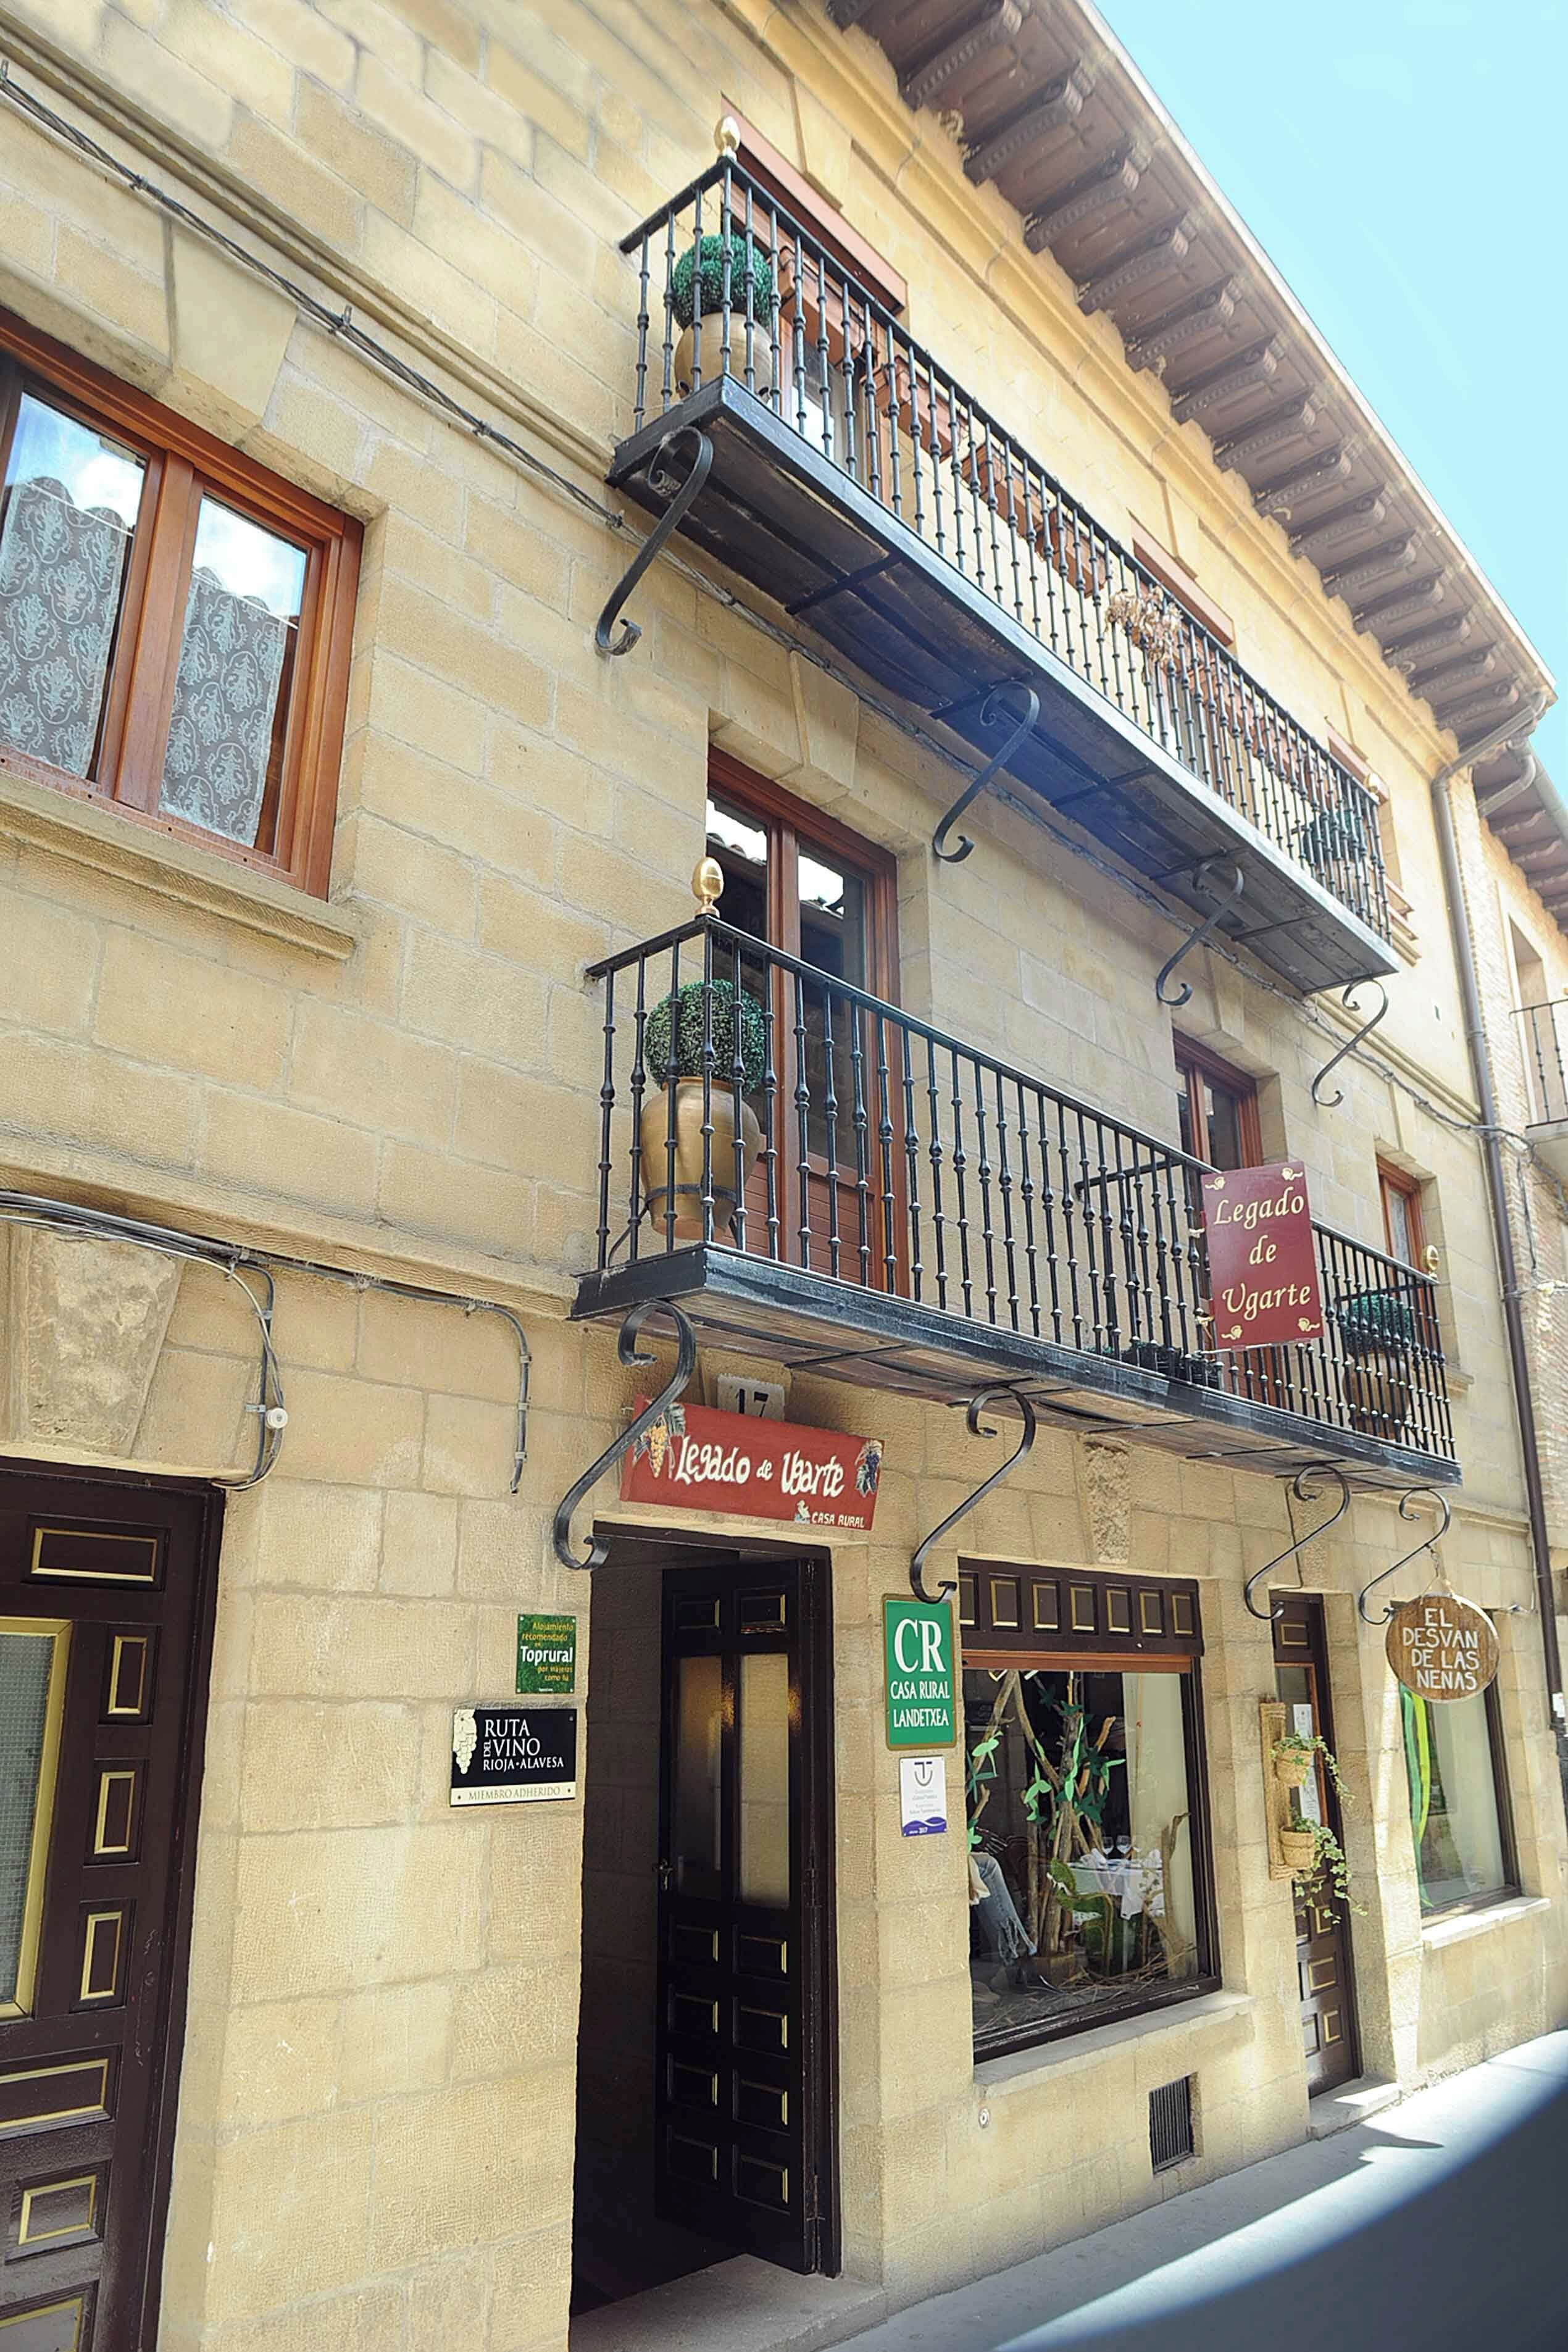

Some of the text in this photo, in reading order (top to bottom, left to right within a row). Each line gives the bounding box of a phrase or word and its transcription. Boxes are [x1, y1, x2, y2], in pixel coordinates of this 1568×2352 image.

[1214, 1186, 1304, 1230] Legado
[1249, 1235, 1277, 1265] de
[1222, 1283, 1311, 1320] Ugarte
[735, 1388, 770, 1417] 17
[674, 1435, 845, 1497] Legado de Ugarte
[811, 1511, 865, 1528] CASA RURAL
[1425, 1608, 1453, 1628] EL
[894, 1618, 946, 1673] CR
[1402, 1627, 1478, 1649] DESVAN
[520, 1646, 573, 1666] Toprural
[1412, 1649, 1480, 1670] DE LAS
[890, 1680, 951, 1699] CASA RURAL
[1416, 1669, 1477, 1691] NENAS
[893, 1708, 949, 1727] LANDETXEA
[485, 1719, 530, 1738] RUTA
[483, 1739, 491, 1758] DEL
[493, 1738, 541, 1757] VINO
[469, 1786, 561, 1801] MIEMBRO ADHERIDO
